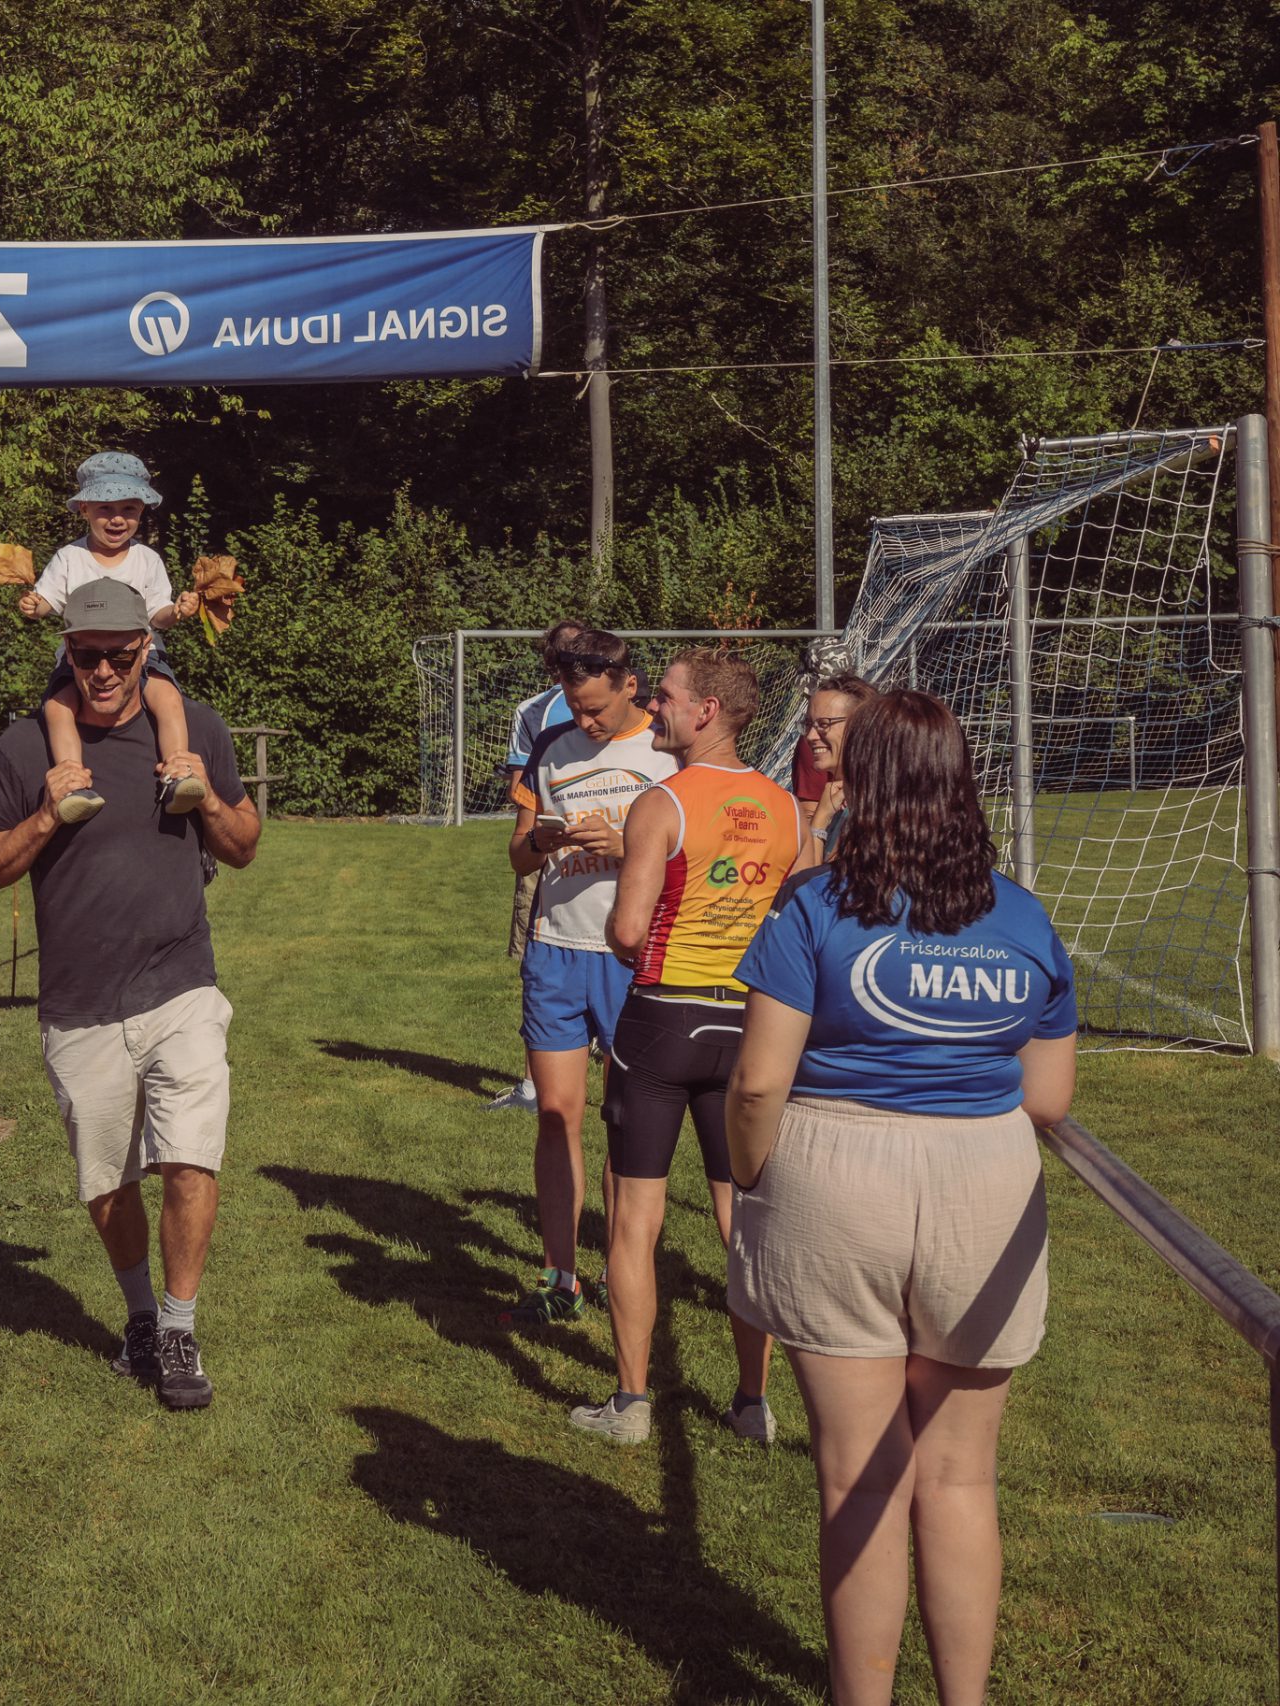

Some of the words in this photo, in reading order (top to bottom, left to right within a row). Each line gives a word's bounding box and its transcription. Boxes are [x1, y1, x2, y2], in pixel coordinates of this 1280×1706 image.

[567, 788, 609, 800] MARATHON
[723, 806, 766, 819] Vitalhaus
[732, 818, 758, 830] Team
[900, 940, 1008, 960] Friseursalon
[909, 963, 1029, 1003] MANU
